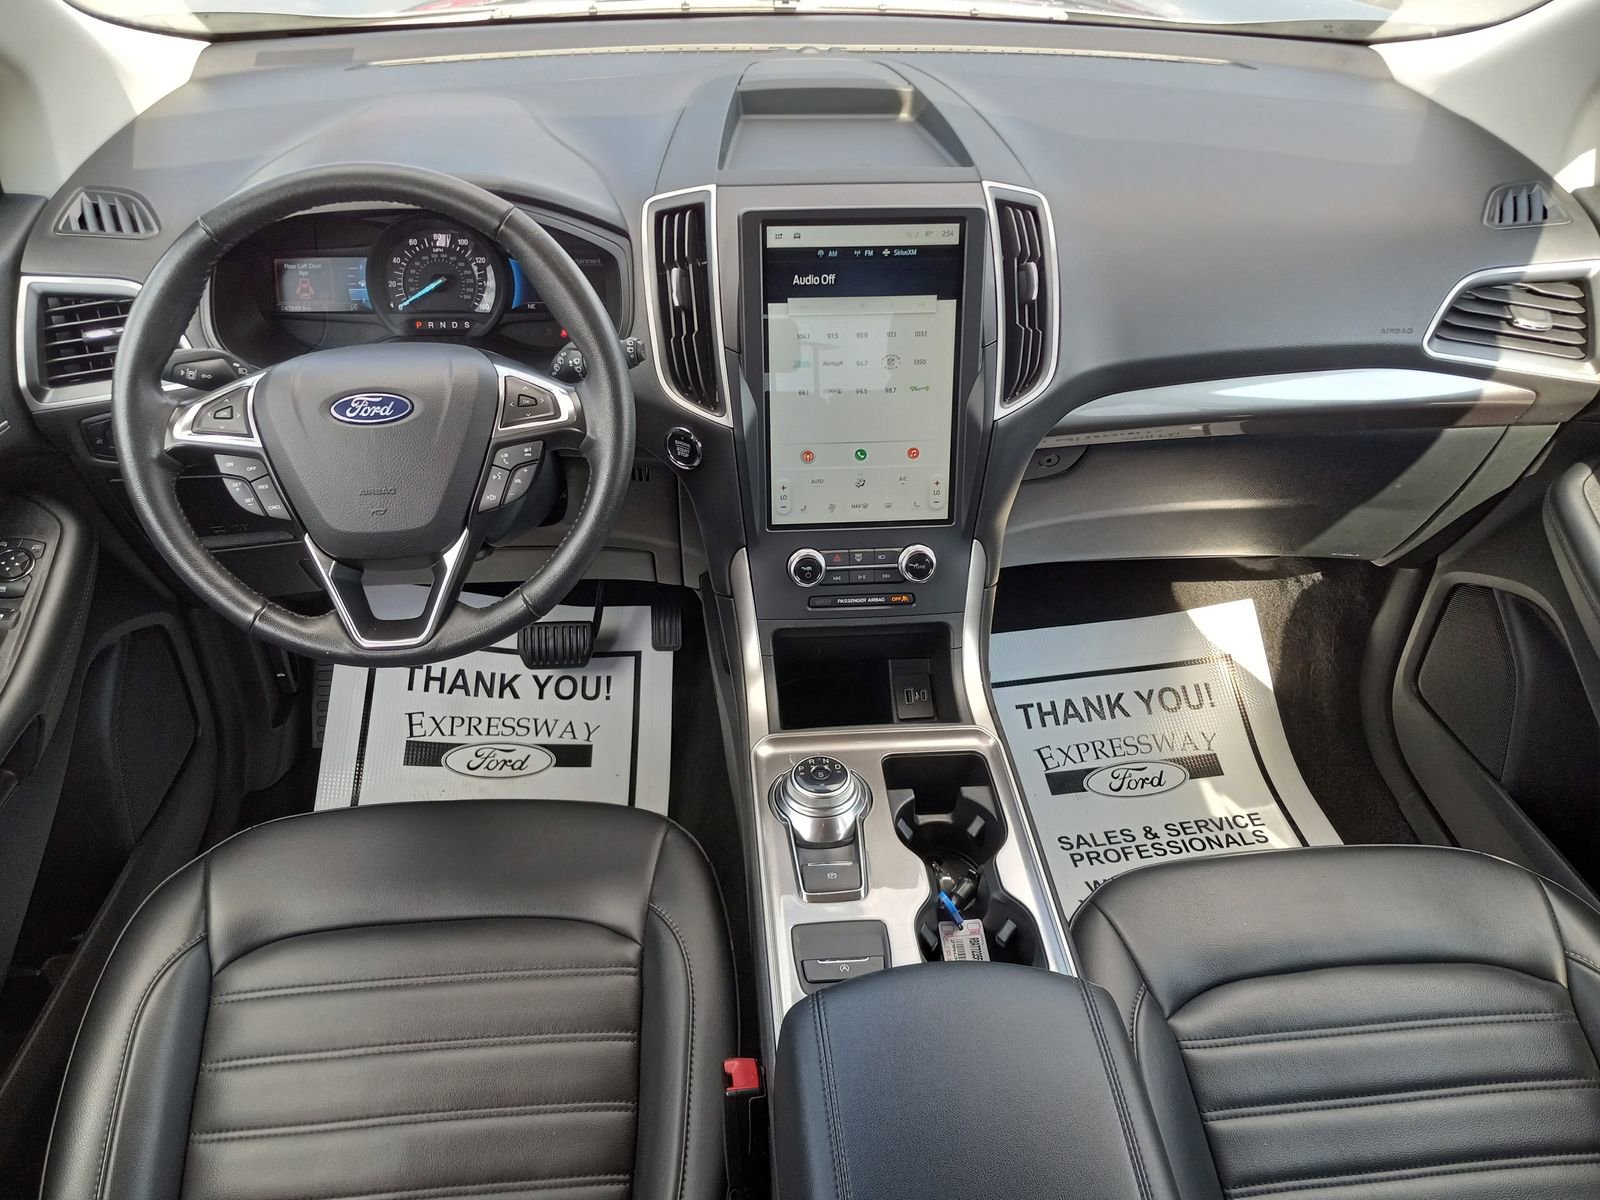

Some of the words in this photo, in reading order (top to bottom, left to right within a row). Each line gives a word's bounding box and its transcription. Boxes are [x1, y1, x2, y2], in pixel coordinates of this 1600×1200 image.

[792, 275, 820, 285] Audio
[821, 274, 836, 284] Off
[346, 397, 394, 417] Ford
[360, 488, 396, 496] AIRBAG
[407, 665, 522, 700] THANK
[532, 674, 612, 700] YOU!
[1015, 692, 1132, 730] THANK
[1134, 682, 1216, 716] YOU!
[404, 712, 600, 742] EXPRESSWAY
[466, 746, 531, 772] Ford
[1034, 732, 1216, 772] EXPRESSWAY
[1108, 766, 1166, 792] Ford
[1057, 828, 1136, 852] SALES
[1143, 826, 1158, 840] &
[1163, 812, 1266, 836] SERVICE
[1069, 830, 1269, 868] PROFESSIONALS
